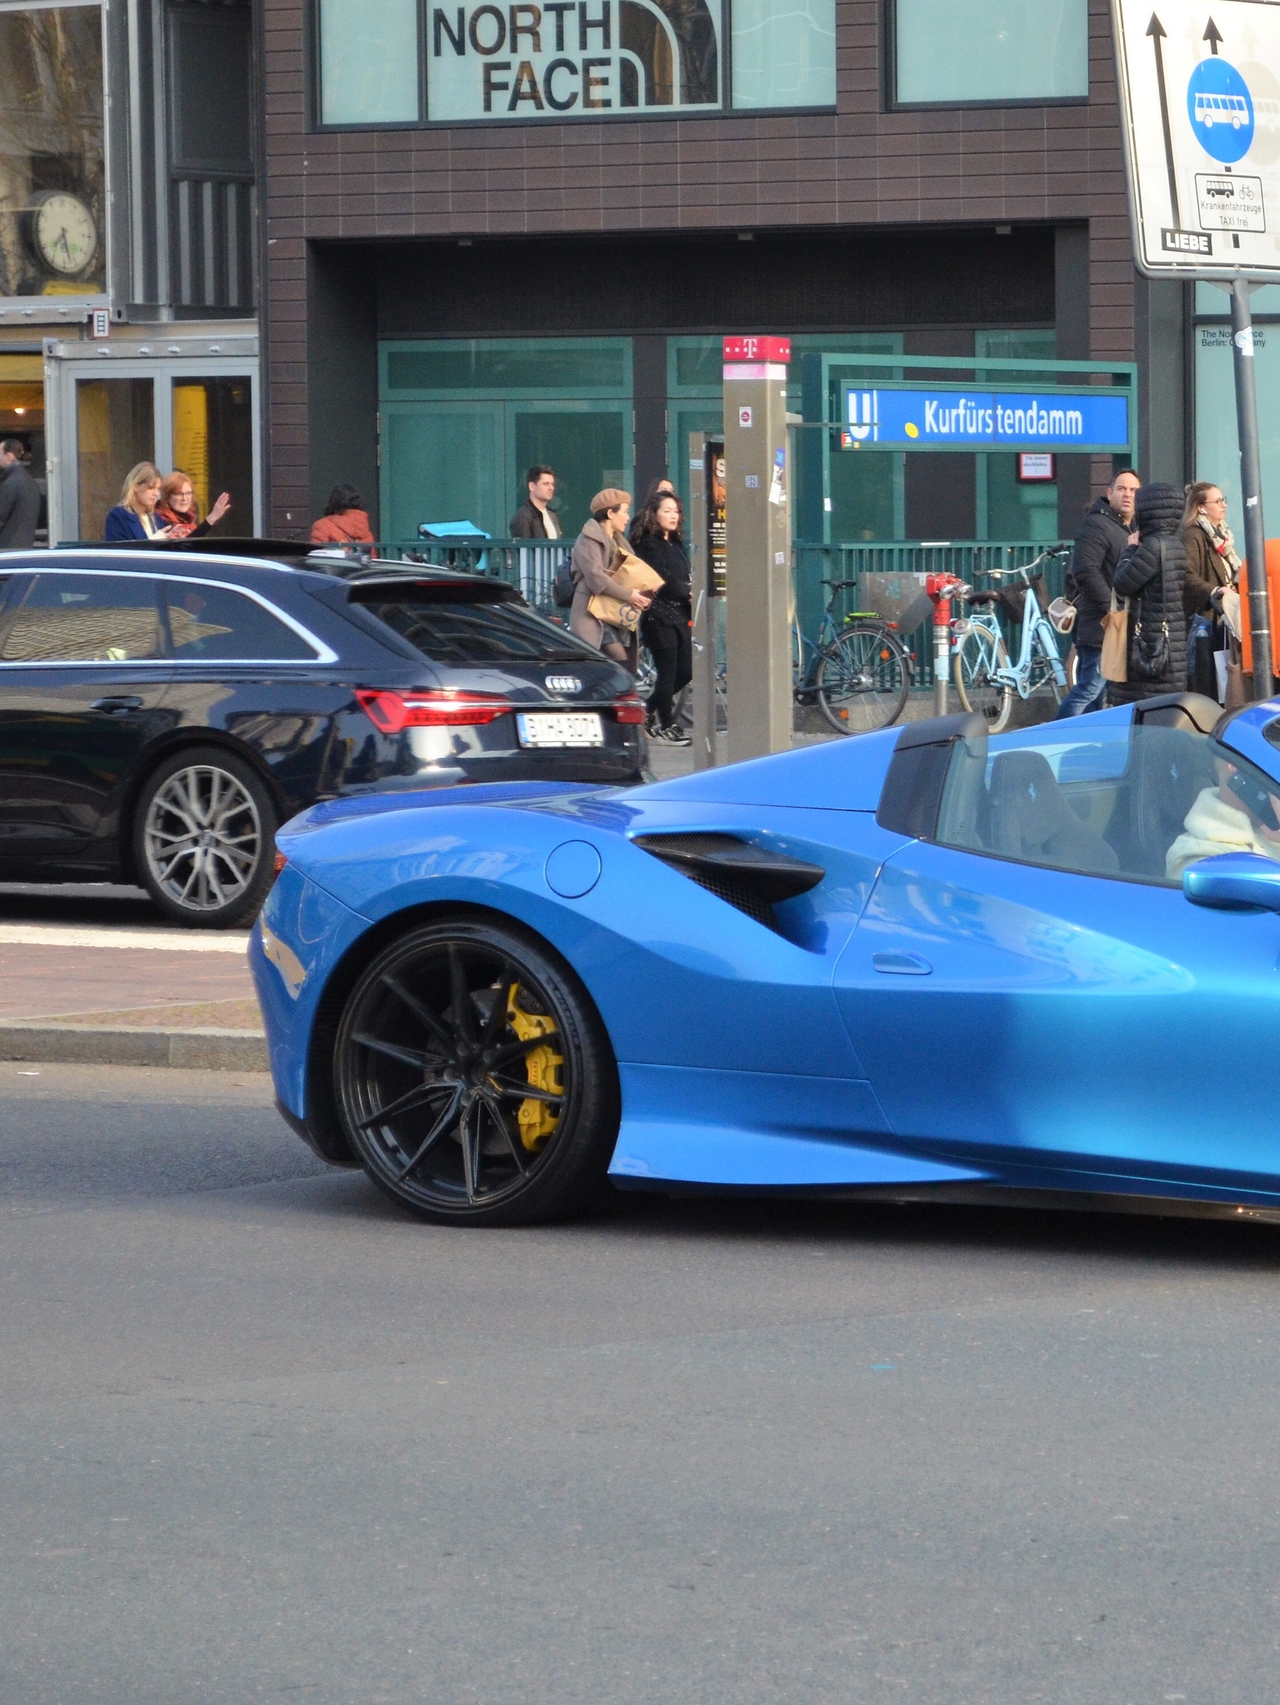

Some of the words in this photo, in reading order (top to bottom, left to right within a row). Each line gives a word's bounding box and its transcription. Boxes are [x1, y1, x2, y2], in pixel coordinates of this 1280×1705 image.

[433, 1, 612, 57] NORTH
[482, 57, 612, 112] FACE
[1200, 200, 1262, 215] Krankenfahrzeuge
[1219, 215, 1235, 226] TAXI
[1237, 216, 1249, 227] frei
[1165, 231, 1210, 252] LIEBE
[1201, 329, 1219, 338] The
[1201, 338, 1226, 347] Berlin:
[743, 338, 758, 358] T
[848, 393, 871, 439] U
[924, 399, 1083, 436] Kurfürstendamm
